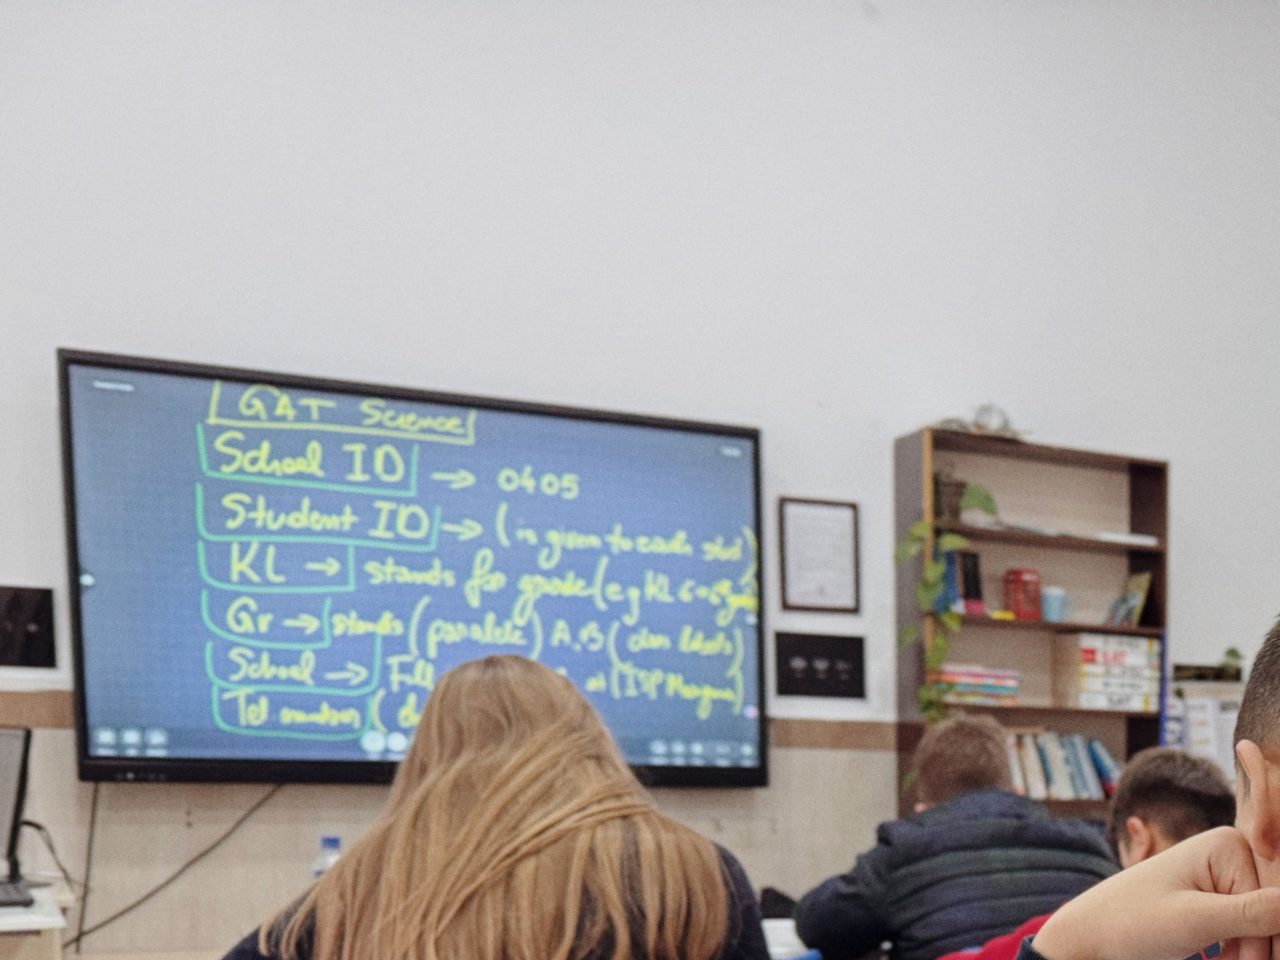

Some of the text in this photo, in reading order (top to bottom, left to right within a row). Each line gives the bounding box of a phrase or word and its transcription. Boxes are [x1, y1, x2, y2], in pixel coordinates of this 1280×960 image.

[360, 399, 466, 432] Science
[214, 431, 324, 478] School
[498, 465, 580, 499] 0405
[221, 492, 359, 529] Student
[364, 557, 456, 588] stands
[226, 596, 274, 634] Gr
[228, 646, 316, 686] School
